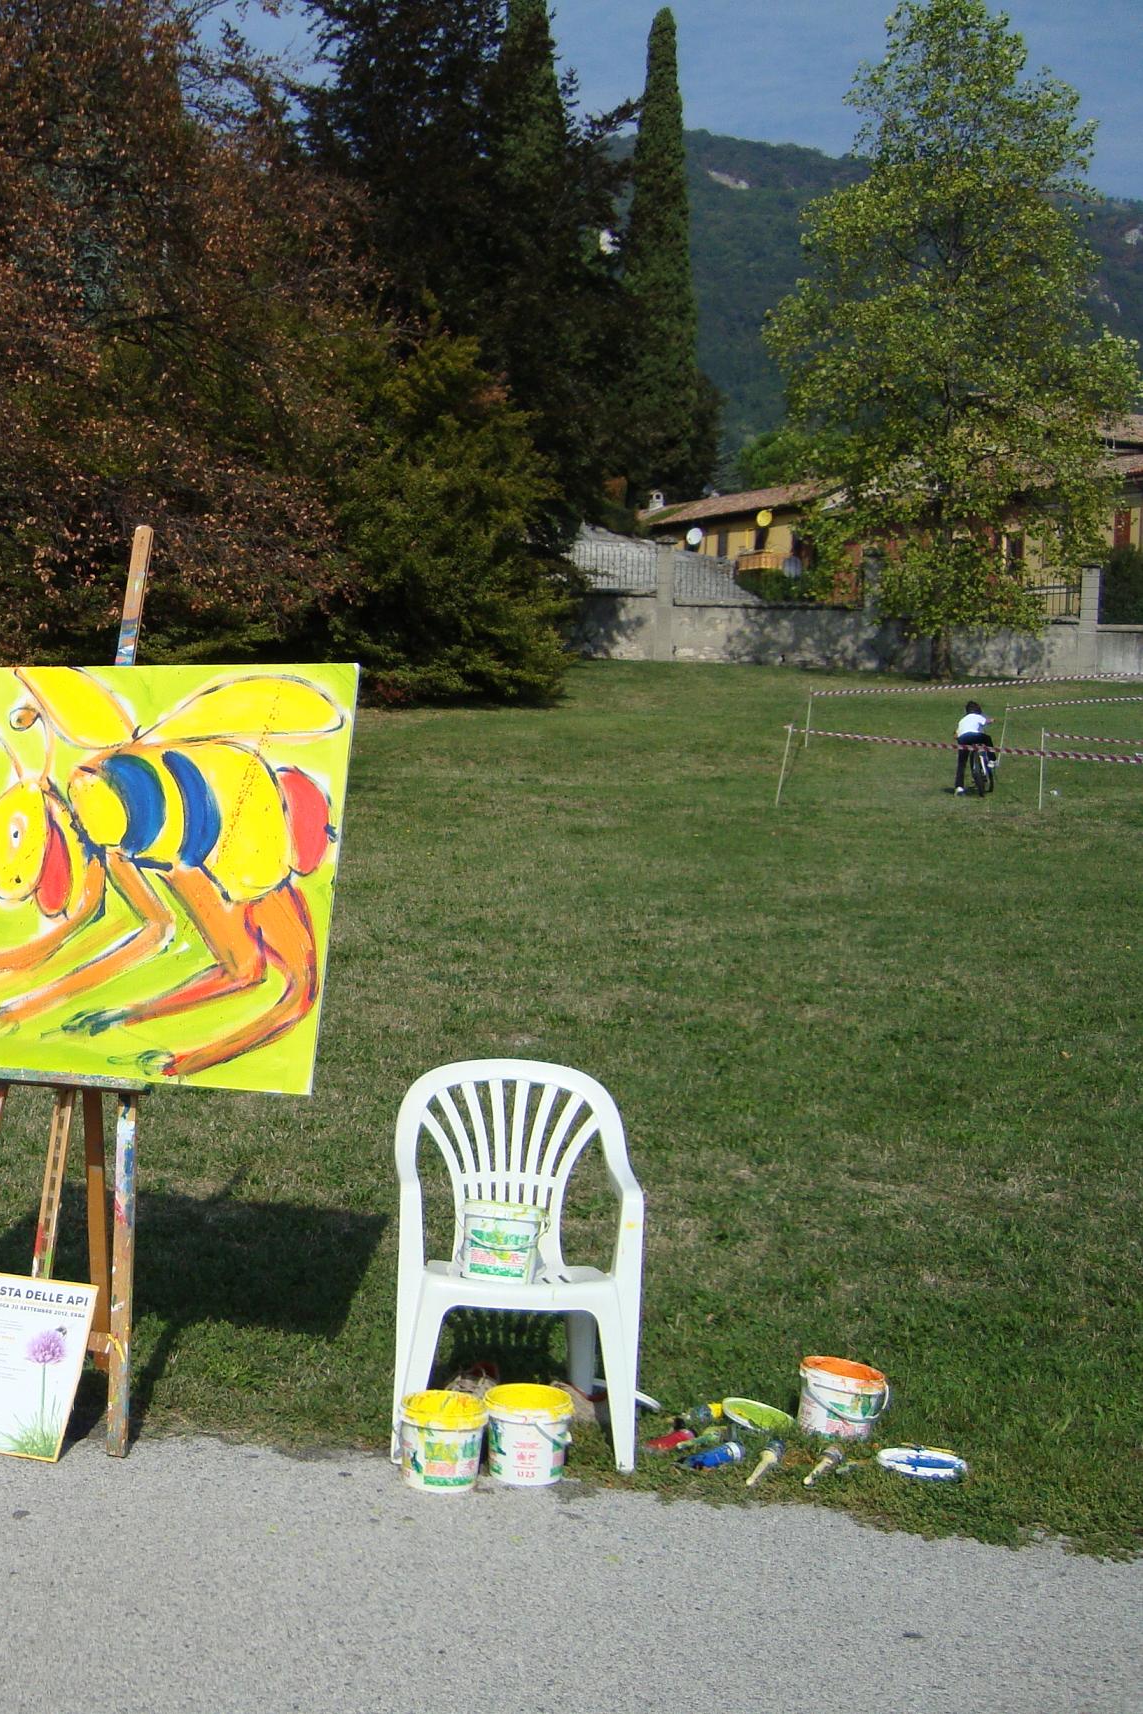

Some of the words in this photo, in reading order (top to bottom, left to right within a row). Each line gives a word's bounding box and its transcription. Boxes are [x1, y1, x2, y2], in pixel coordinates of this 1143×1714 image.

[25, 1289, 64, 1304] DELLE
[66, 1295, 89, 1307] API
[20, 1305, 53, 1315] SETTEMBRE
